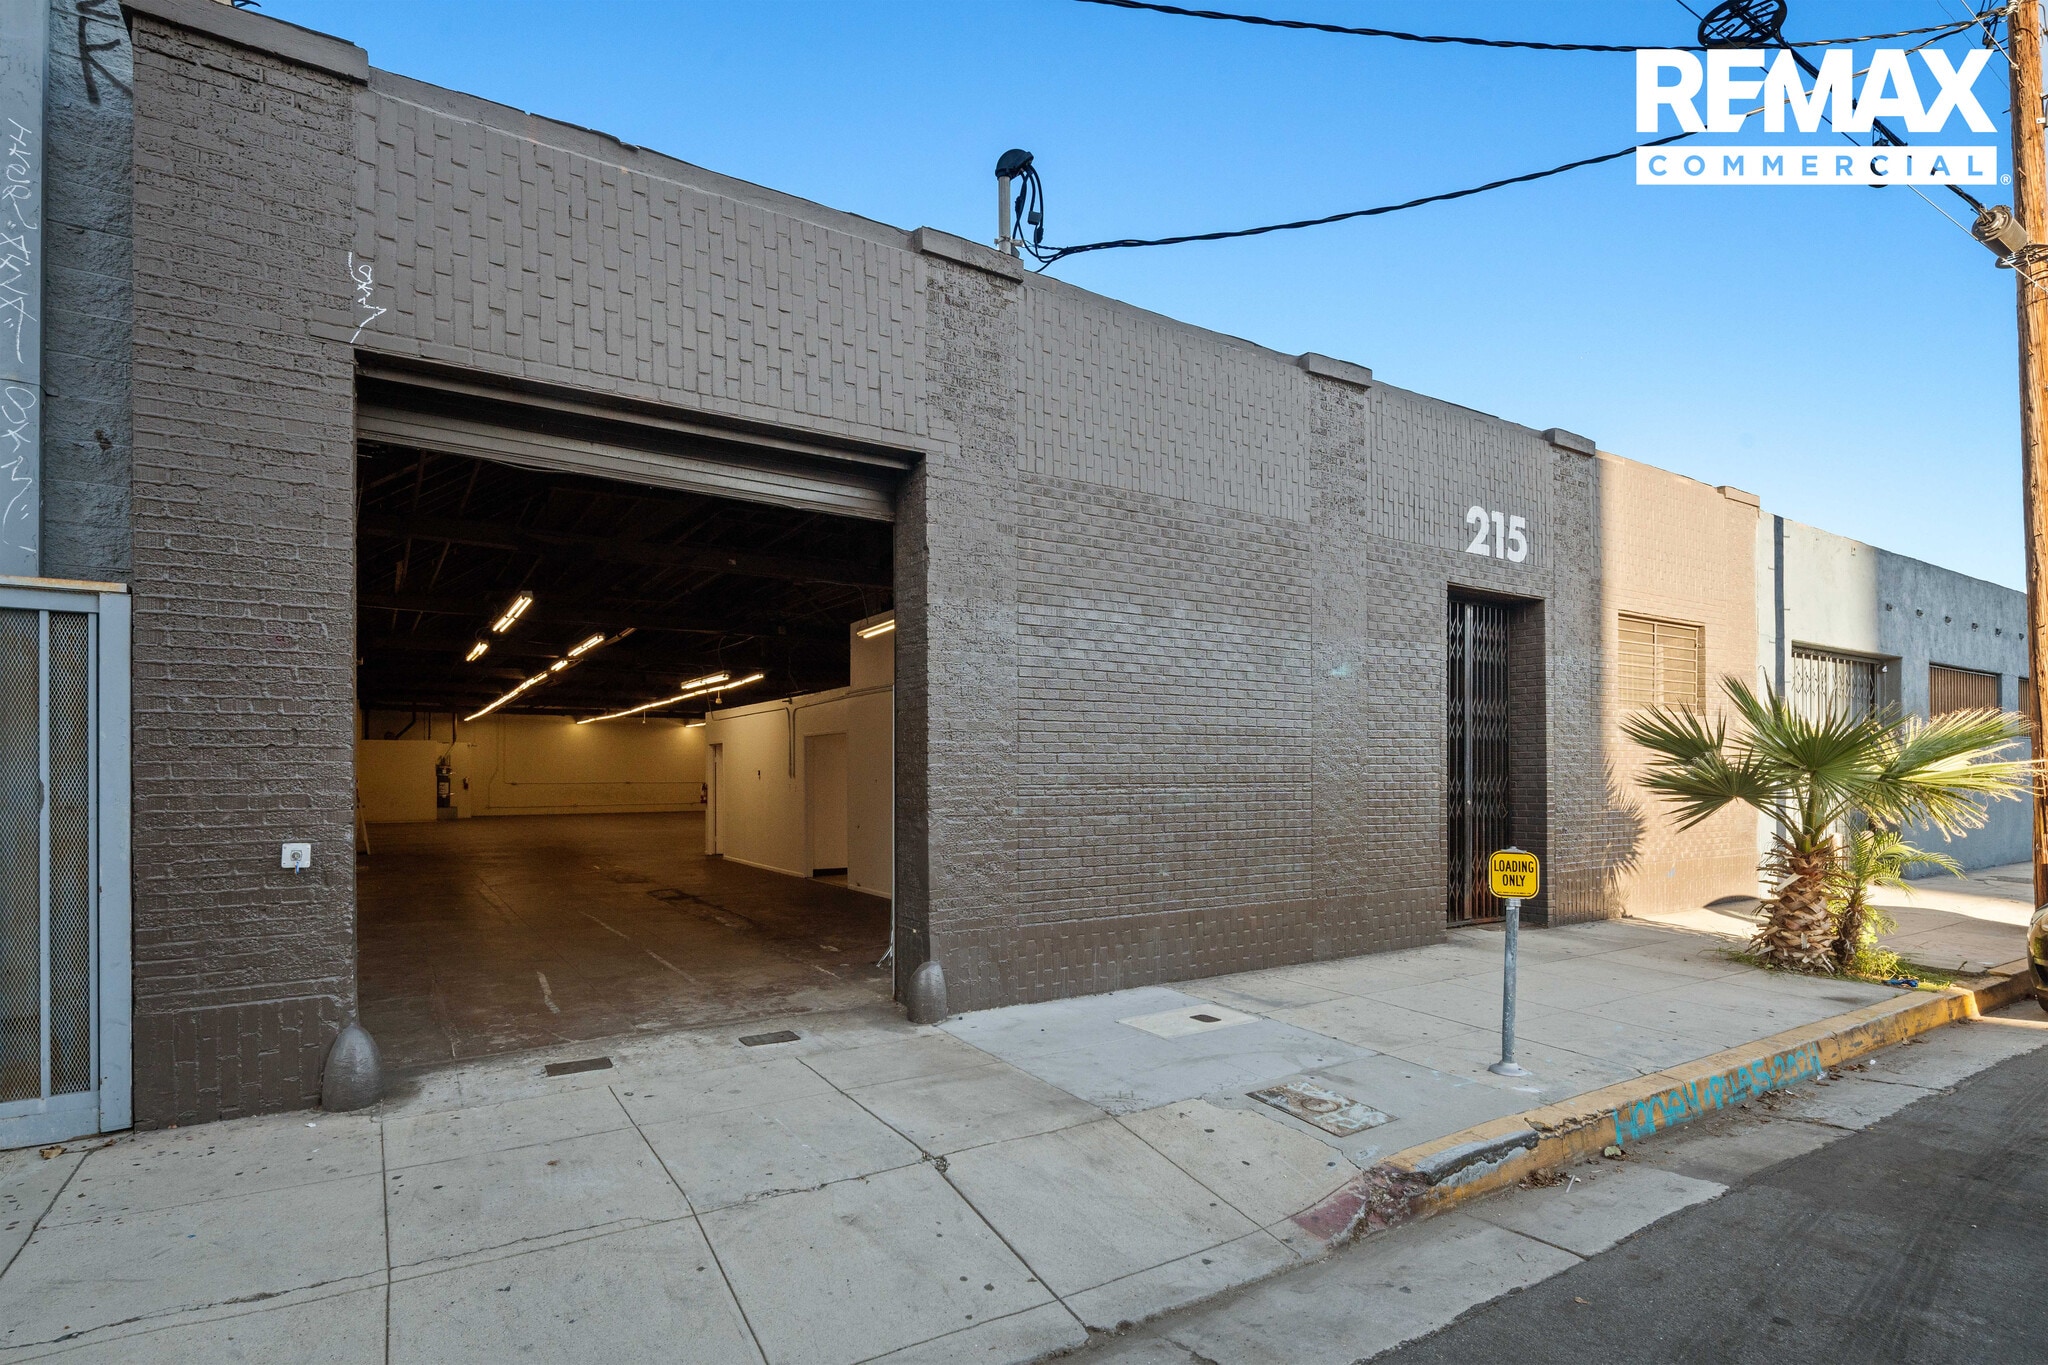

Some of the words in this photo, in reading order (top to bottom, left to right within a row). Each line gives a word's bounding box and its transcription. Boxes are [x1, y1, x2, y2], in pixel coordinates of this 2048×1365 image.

[1465, 505, 1528, 563] 215
[1493, 860, 1534, 873] LOADING
[1502, 874, 1526, 887] ONLY
